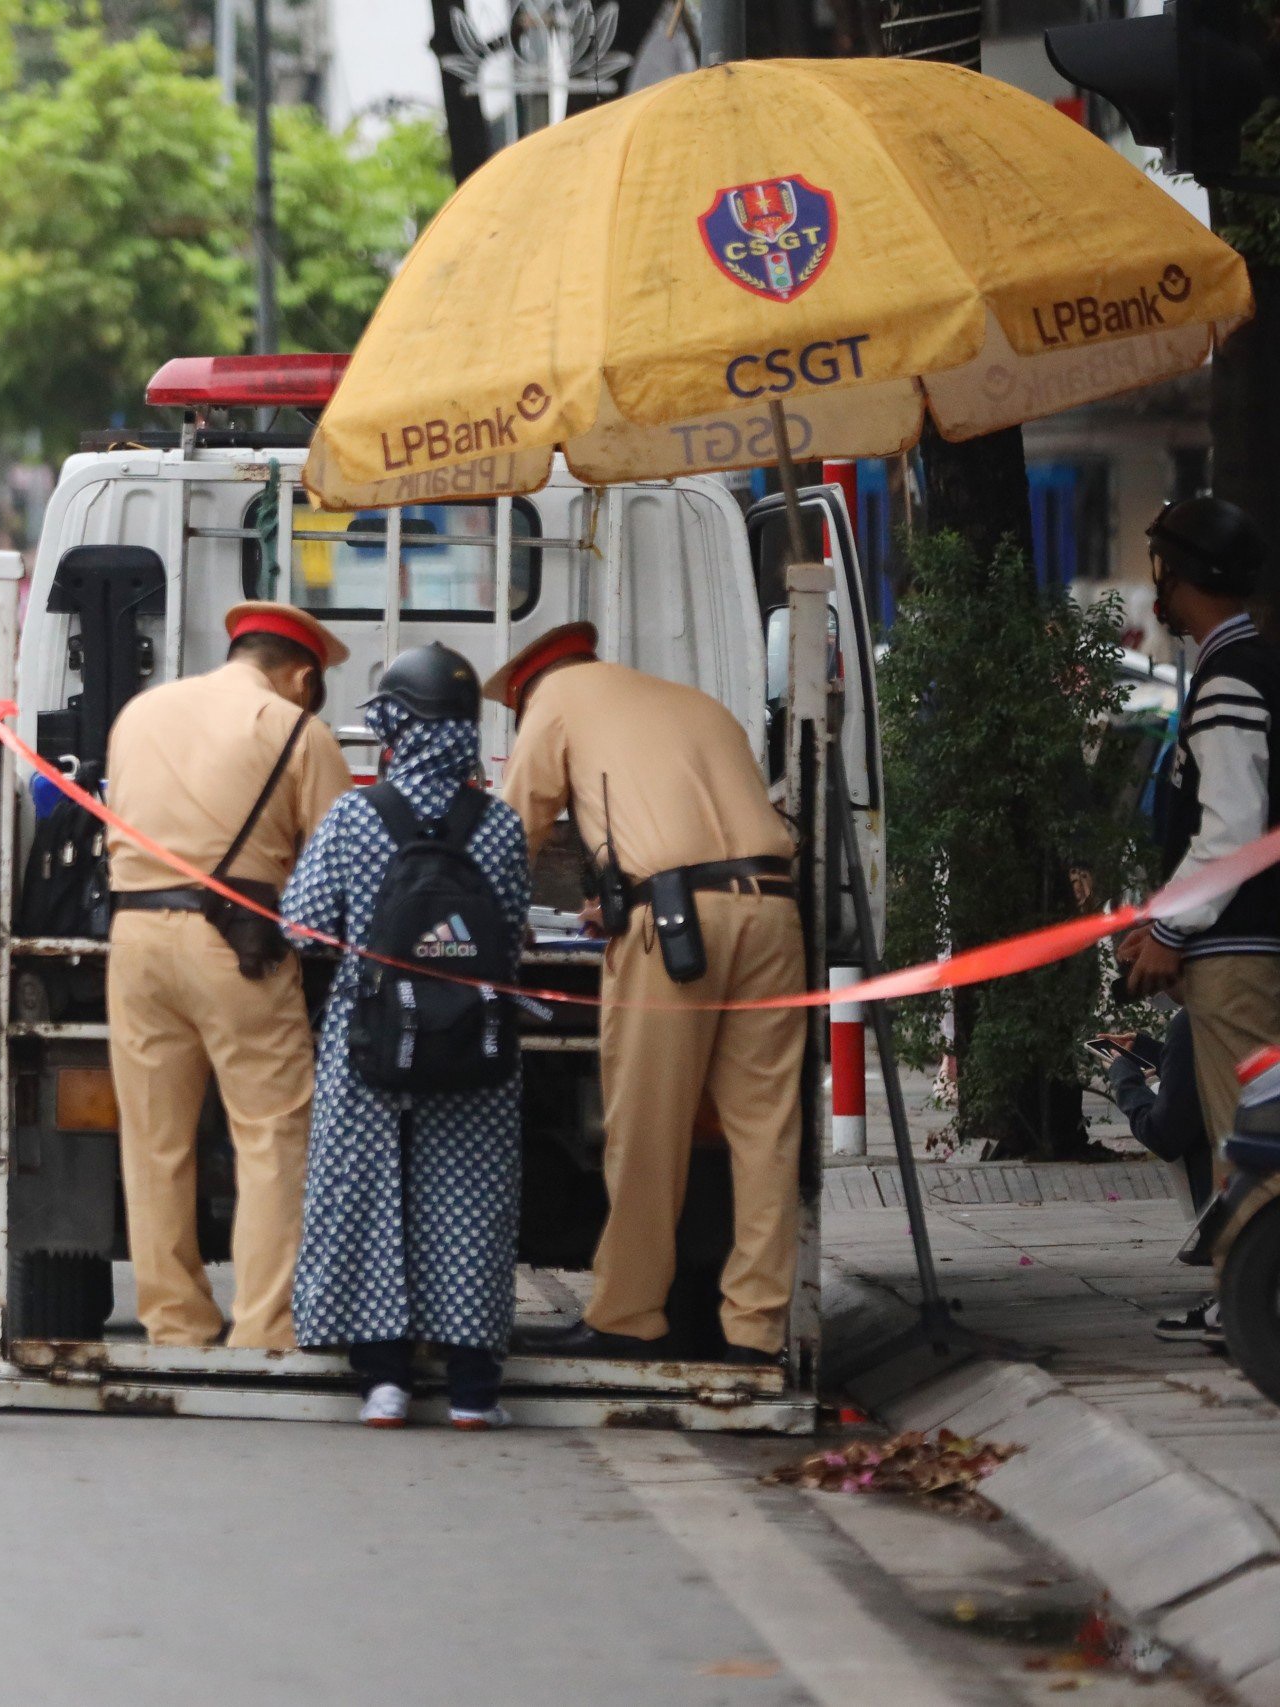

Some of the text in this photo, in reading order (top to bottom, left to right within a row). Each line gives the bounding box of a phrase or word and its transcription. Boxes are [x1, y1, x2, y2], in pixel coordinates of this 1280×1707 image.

[725, 226, 821, 260] CSGT
[1032, 286, 1164, 346] LPBank
[725, 333, 870, 398] CSGT
[381, 407, 518, 471] LPBank
[415, 941, 478, 958] adidas
